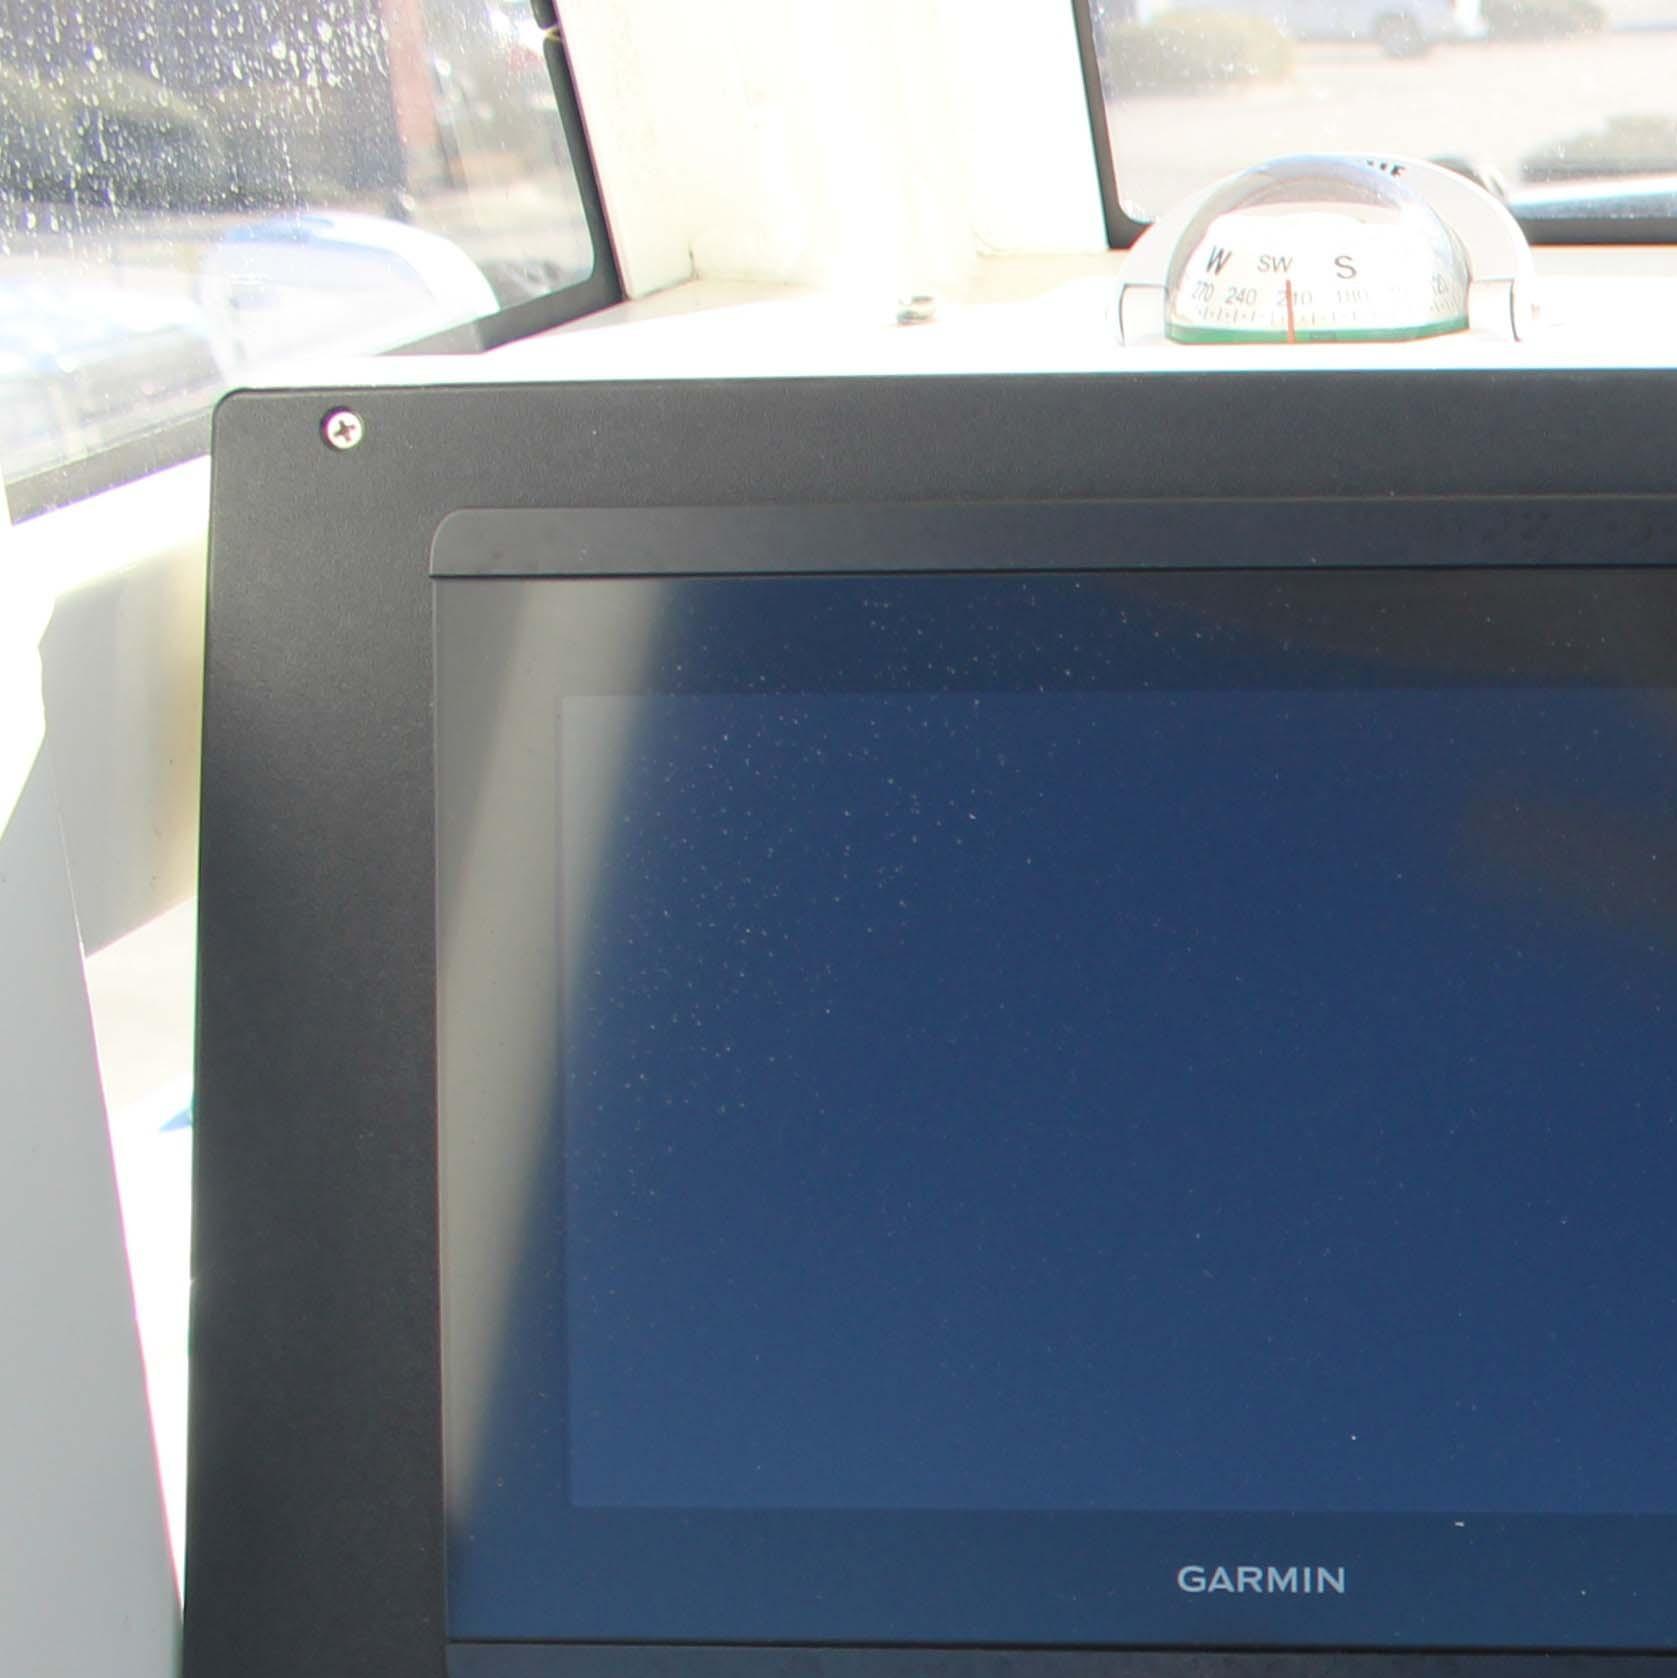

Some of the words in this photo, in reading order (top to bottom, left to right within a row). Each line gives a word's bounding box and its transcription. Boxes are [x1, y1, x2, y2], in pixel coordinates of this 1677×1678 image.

[1206, 245, 1232, 275] W
[1257, 253, 1293, 273] SW
[1332, 254, 1357, 280] S
[1224, 285, 1257, 305] 240
[1176, 1565, 1345, 1594] GARMIN
